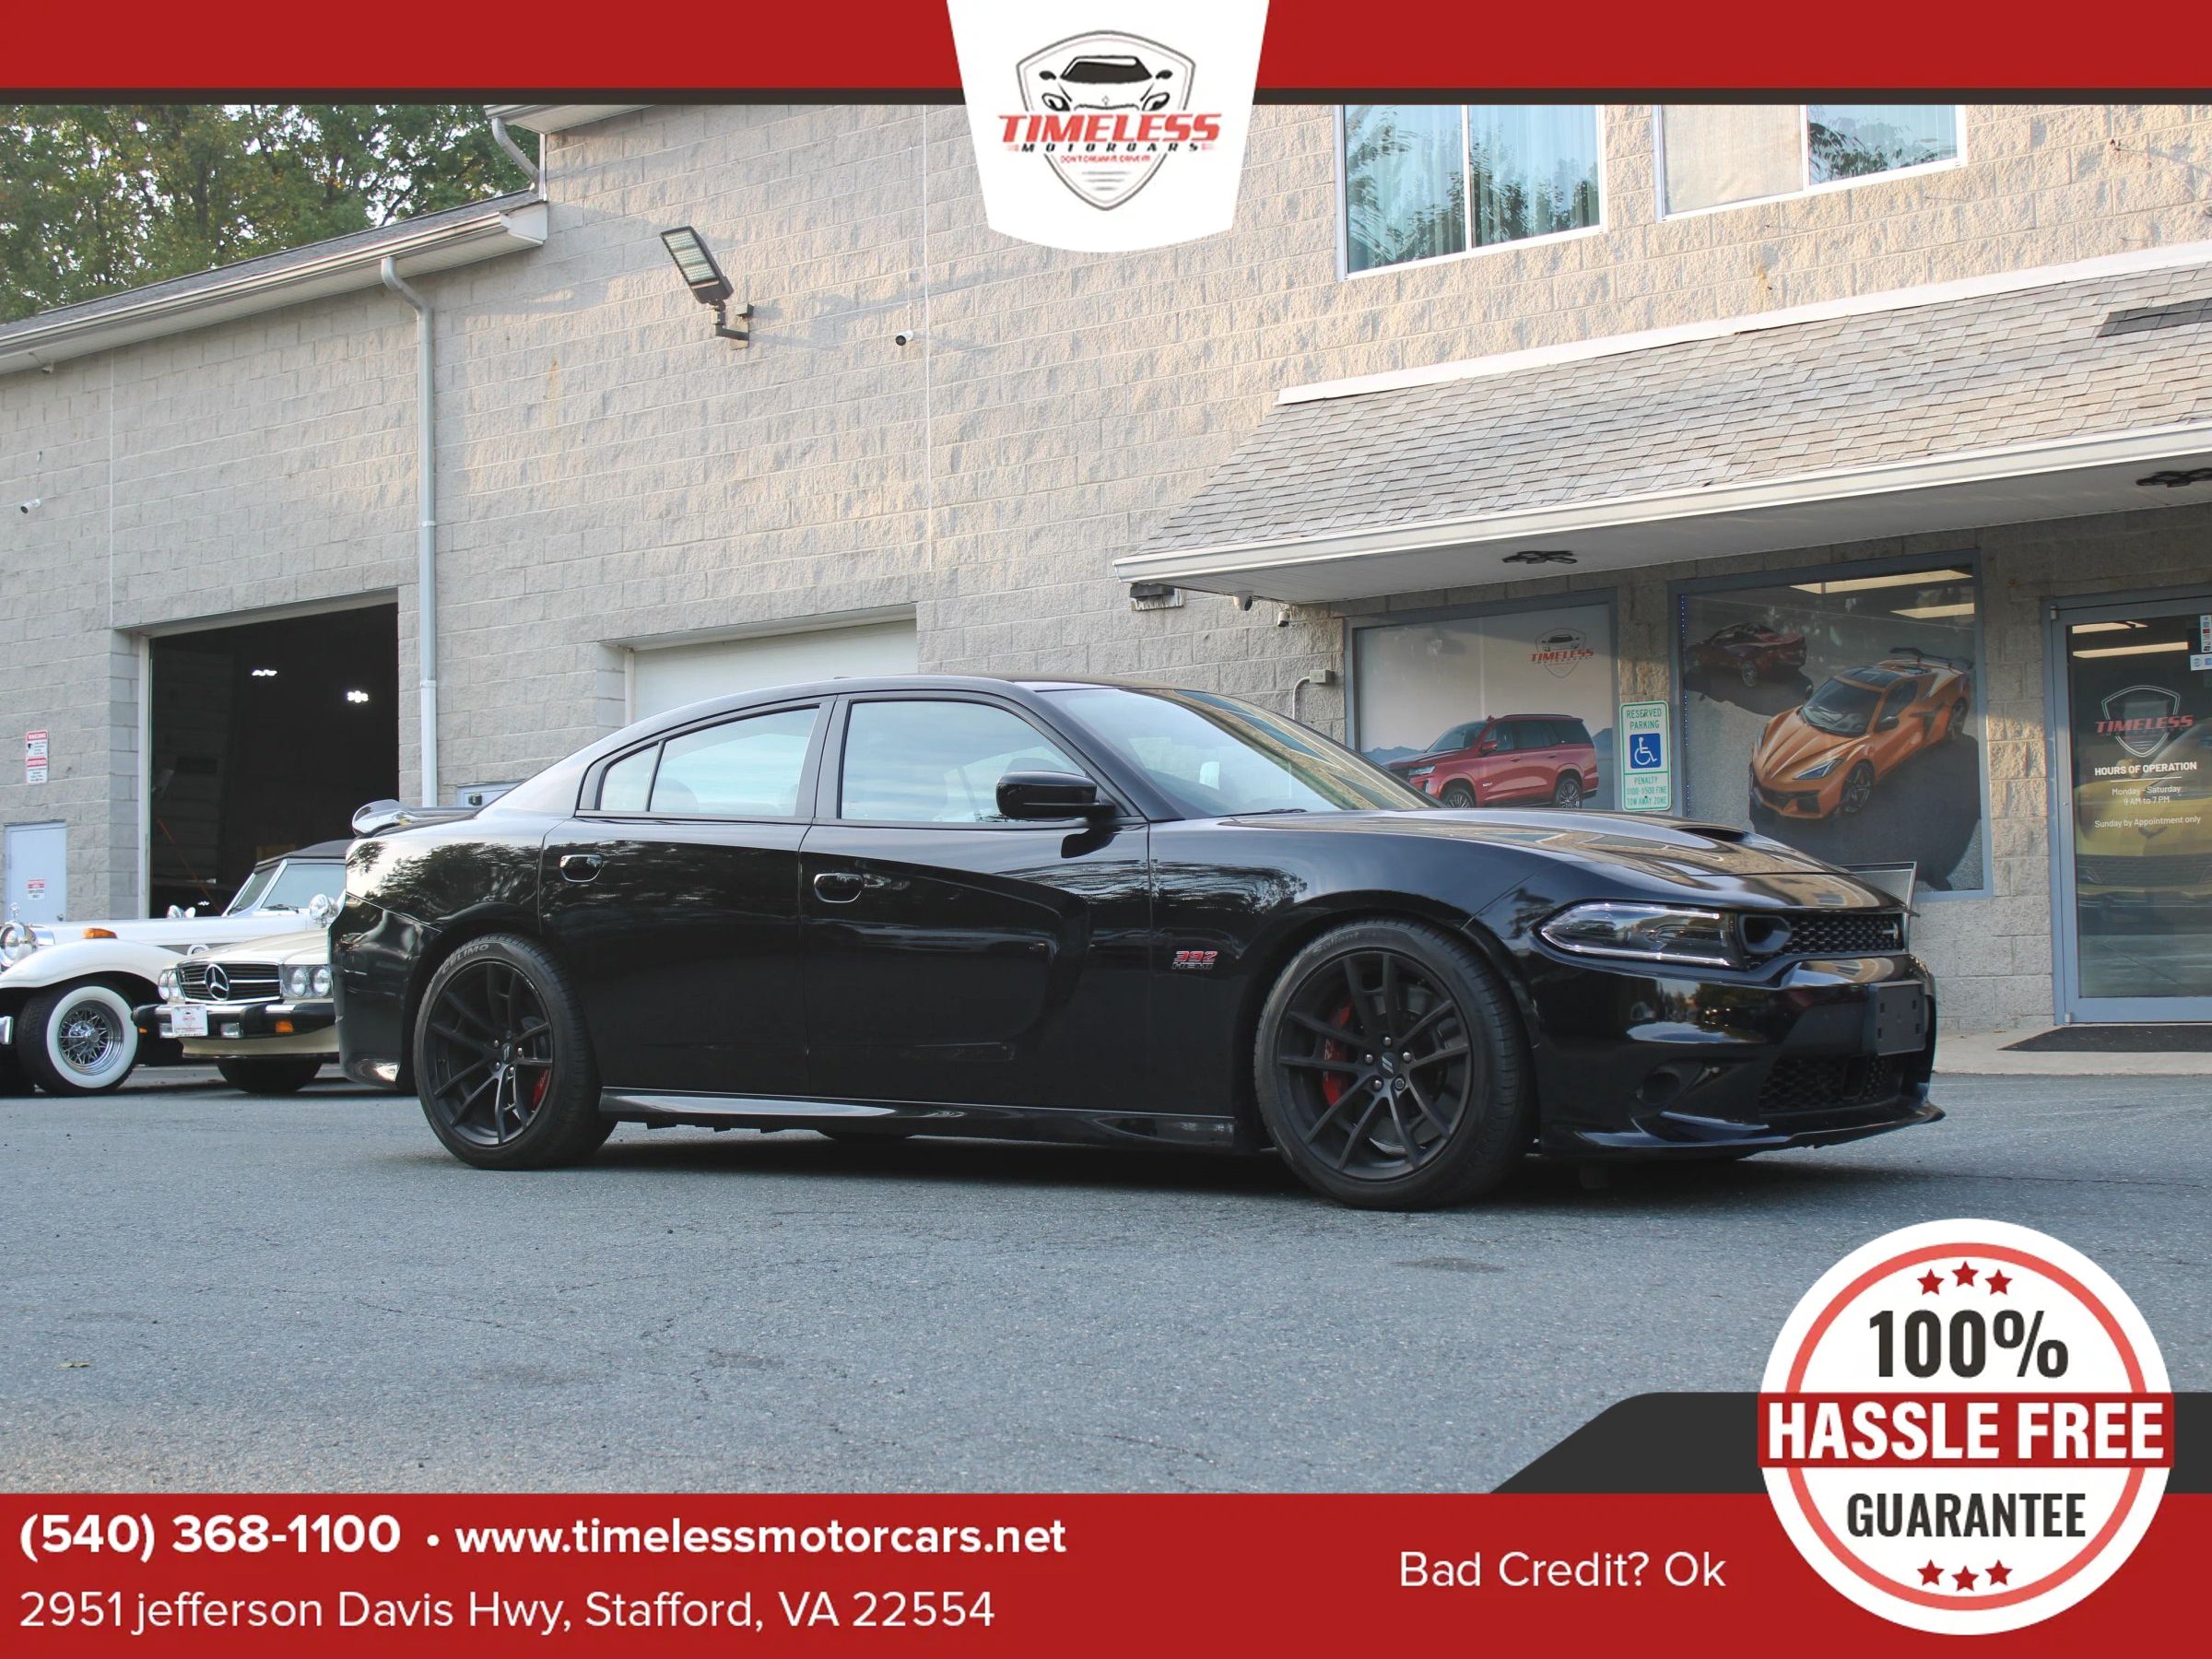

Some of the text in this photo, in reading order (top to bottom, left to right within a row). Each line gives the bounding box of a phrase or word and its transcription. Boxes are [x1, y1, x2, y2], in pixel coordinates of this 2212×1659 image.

[1530, 649, 1594, 662] TIMELESS
[1626, 708, 1663, 719] RESERVED
[1630, 720, 1660, 731] PARKING
[2095, 714, 2194, 734] TIMELESS
[2095, 761, 2197, 776] HOURS OF OPERATION
[1634, 776, 1657, 785] PENALTY
[1656, 785, 1667, 794] FINE
[2112, 788, 2140, 797] Monday
[2147, 785, 2182, 794] Saturday
[1654, 796, 1667, 805] ZONE
[2130, 797, 2141, 806] AM
[2095, 816, 2201, 829] Sunday by Appointment only
[1173, 950, 1218, 962] 392
